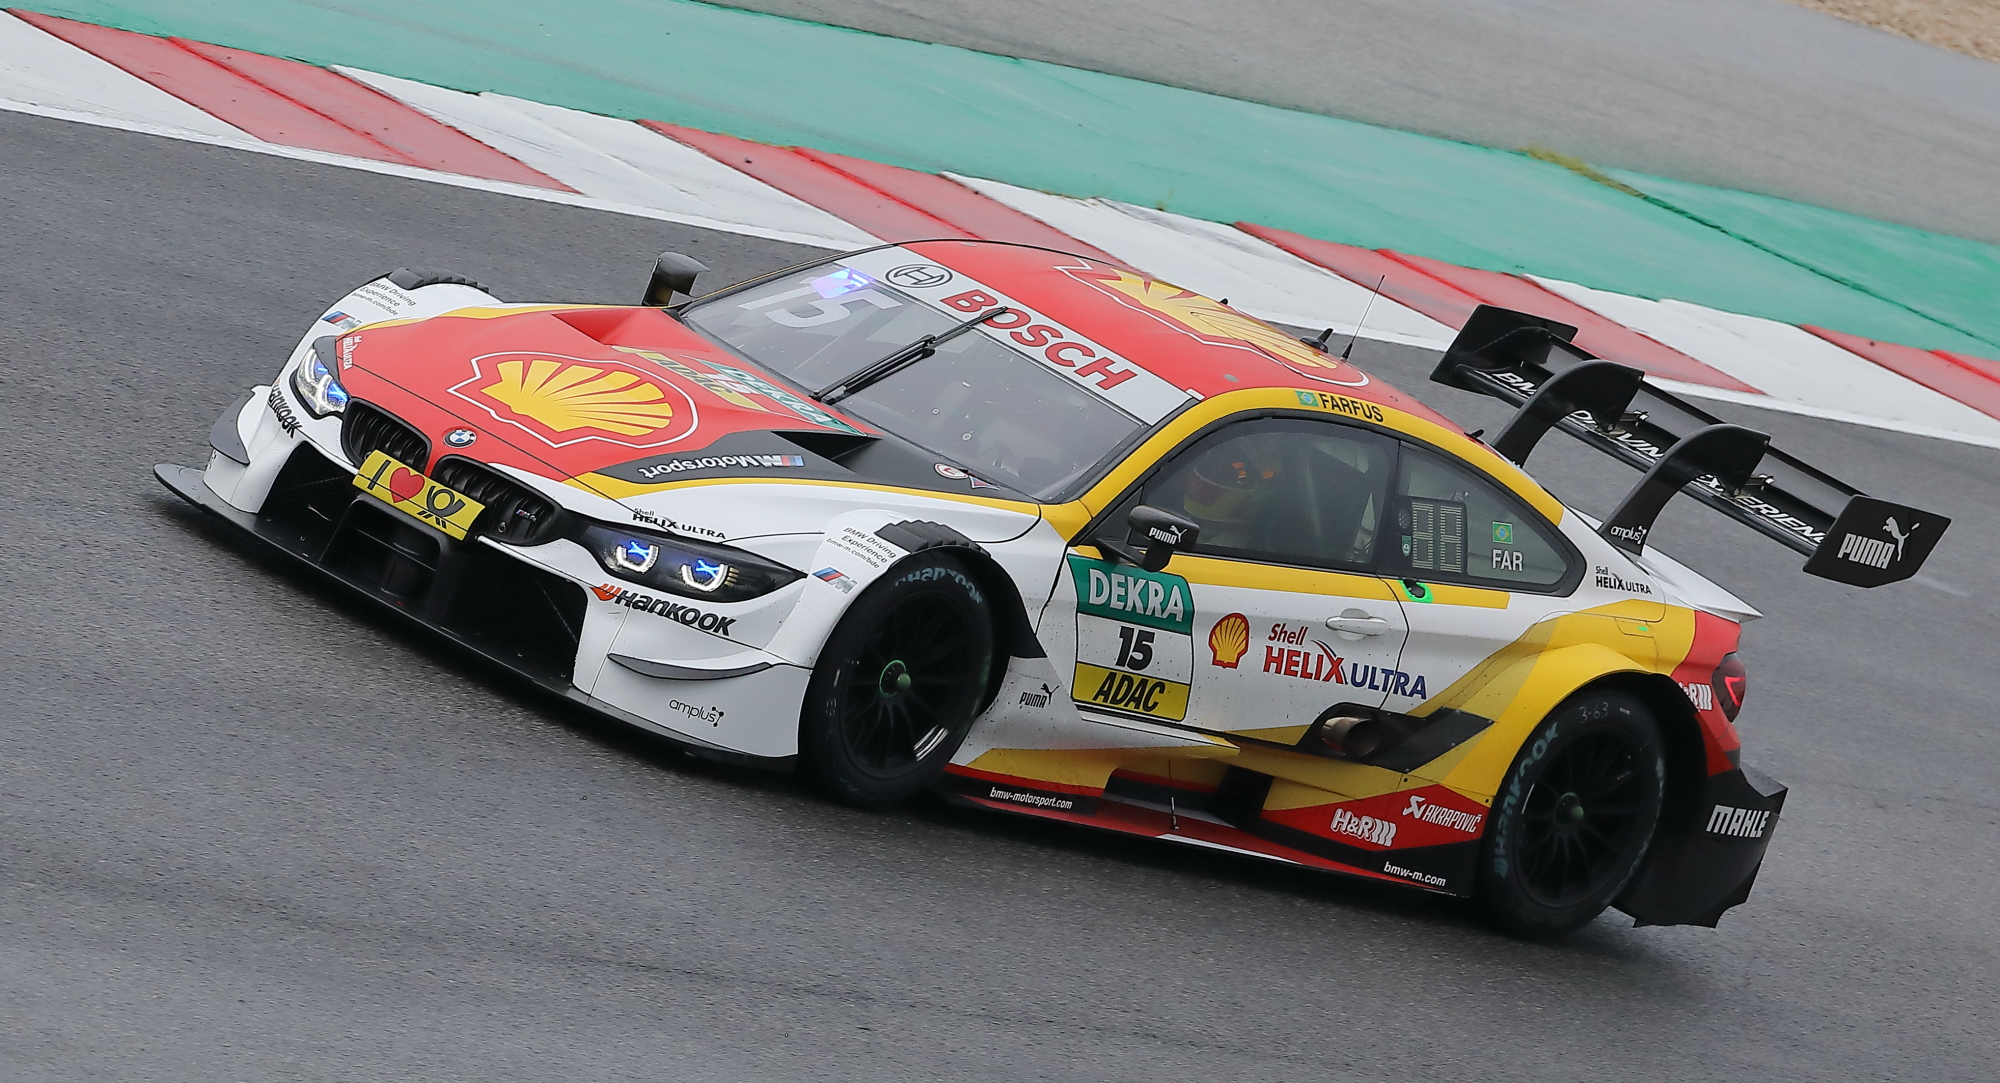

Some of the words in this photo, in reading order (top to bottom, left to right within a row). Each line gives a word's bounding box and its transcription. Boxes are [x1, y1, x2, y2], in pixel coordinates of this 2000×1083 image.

[939, 289, 1138, 390] BOSCH
[725, 368, 832, 422] DEKRA
[1491, 372, 1537, 396] BM
[1318, 393, 1384, 422] FARFUS
[638, 455, 759, 478] Motorsport
[681, 524, 726, 540] ULTRA
[843, 527, 868, 540] BMW
[867, 537, 897, 559] Driving
[1149, 527, 1177, 545] PUMA
[826, 538, 880, 569] bmw-m.com/bde
[841, 535, 888, 564] Experience
[1492, 549, 1523, 572] FAR
[1837, 532, 1895, 570] PUMA
[1089, 568, 1184, 622] DEKRA
[1595, 575, 1625, 591] HELIX
[1626, 581, 1653, 595] ULTRA
[1115, 626, 1156, 671] 15
[1268, 623, 1309, 646] Shell
[1263, 644, 1347, 685] HELIX
[1350, 663, 1427, 700] ULTRA
[1019, 692, 1047, 708] PUMA
[1092, 672, 1166, 712] ADAC
[669, 700, 717, 723] amplus
[989, 786, 1073, 810] bmw-motorsport.com
[1330, 808, 1383, 843] H&R
[1706, 804, 1770, 838] MAHLE
[1383, 861, 1446, 887] bmw-m.com
